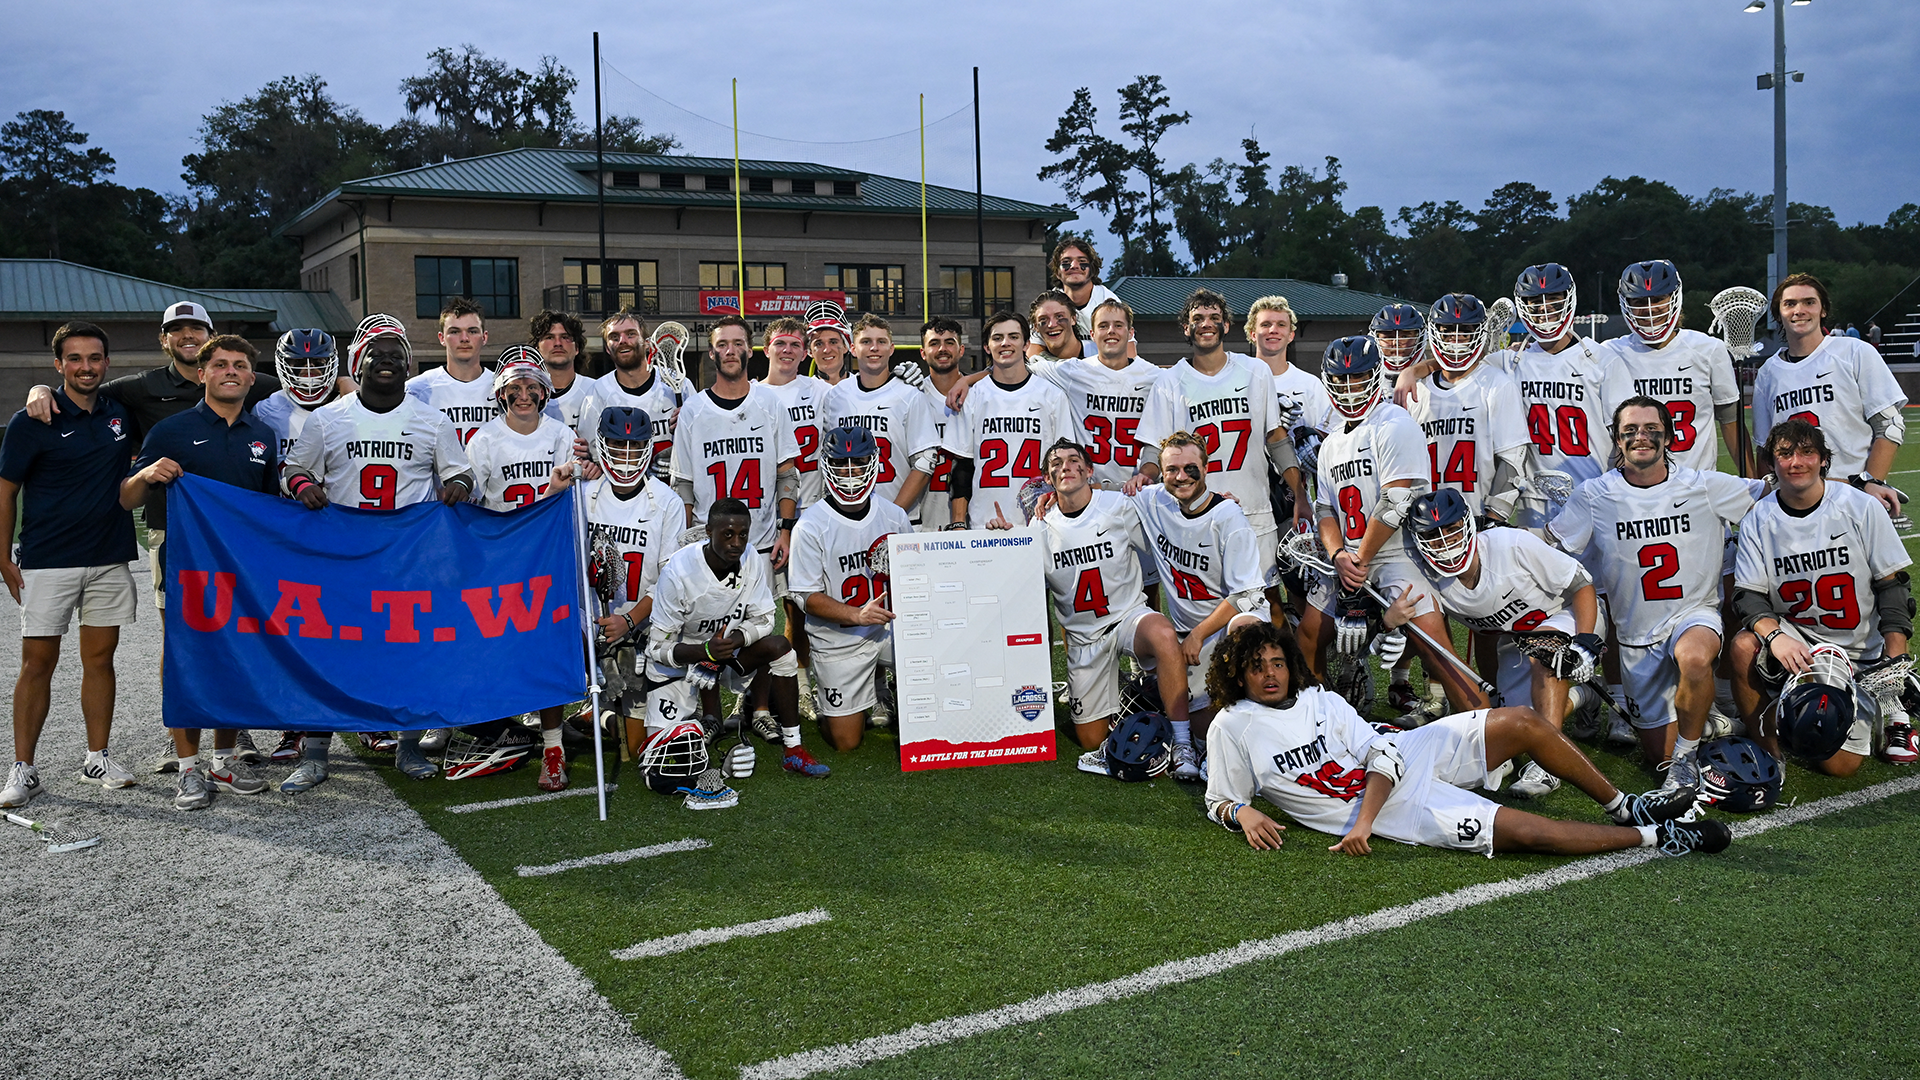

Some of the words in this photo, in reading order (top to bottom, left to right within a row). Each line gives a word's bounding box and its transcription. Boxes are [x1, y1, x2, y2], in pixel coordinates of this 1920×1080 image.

[706, 296, 740, 310] NAIA
[760, 300, 782, 311] RED
[1521, 380, 1584, 401] PATRIOTS
[1634, 378, 1692, 397] ATRIOTS
[1774, 384, 1834, 414] ATRIOTS
[1086, 393, 1144, 412] PATRIOTS
[1189, 397, 1249, 422] PATRIOTS
[982, 417, 1041, 435] PATRIOTS
[1527, 404, 1590, 457] 40
[1665, 400, 1697, 452] 3
[346, 440, 414, 461] PATRIOTS
[703, 437, 764, 458] PATRIOTS
[1084, 415, 1144, 466] 35
[1192, 419, 1252, 474] 27
[501, 461, 554, 481] PATRIOT
[980, 438, 1041, 488] 24
[358, 464, 398, 510] 9
[707, 458, 764, 509] 14
[1338, 484, 1367, 540] 8
[1616, 514, 1690, 541] PATRIOTS
[924, 540, 966, 551] NATIONAL
[970, 537, 1033, 549] CHAMPIONSHIP
[1053, 541, 1114, 570] PATRIOTS
[1157, 534, 1209, 572] PATRIOTS
[838, 550, 868, 573] PATR
[1637, 542, 1683, 602] 2
[1774, 546, 1849, 576] PATRIOTS
[1074, 567, 1110, 618] 4
[1778, 572, 1860, 630] 29
[178, 569, 570, 643] U.A.T.W.
[1465, 598, 1529, 628] PATRIOTS
[700, 661, 720, 671] STX
[659, 698, 678, 720] UC
[824, 688, 843, 707] UC
[1013, 694, 1046, 703] LACROSSE
[920, 753, 952, 762] BATTLE
[952, 752, 968, 760] FOR
[970, 750, 986, 758] THE
[987, 749, 1003, 757] RED
[1004, 746, 1038, 756] BANNER
[1705, 770, 1726, 787] atriots
[1754, 790, 1764, 804] 2
[1457, 818, 1481, 843] UC
